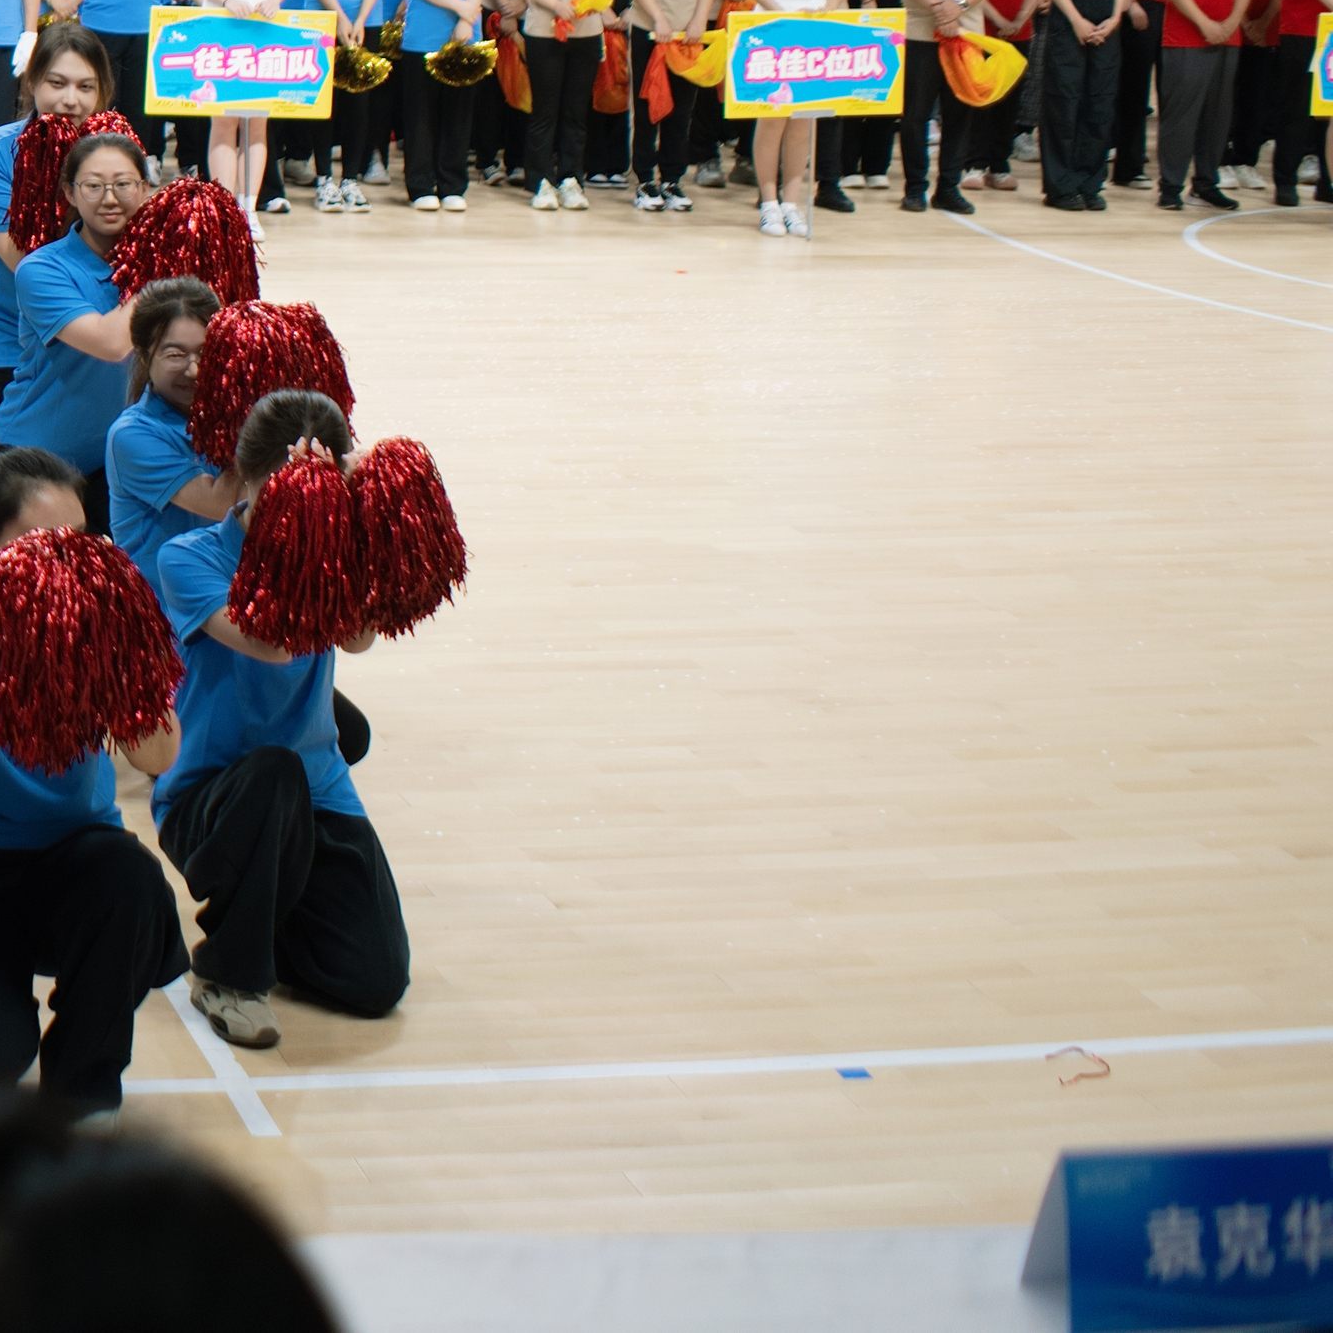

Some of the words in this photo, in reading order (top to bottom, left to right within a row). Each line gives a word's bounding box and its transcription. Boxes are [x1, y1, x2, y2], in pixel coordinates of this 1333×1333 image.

[161, 46, 321, 81] 一往无前队
[746, 46, 884, 80] 最佳C位队
